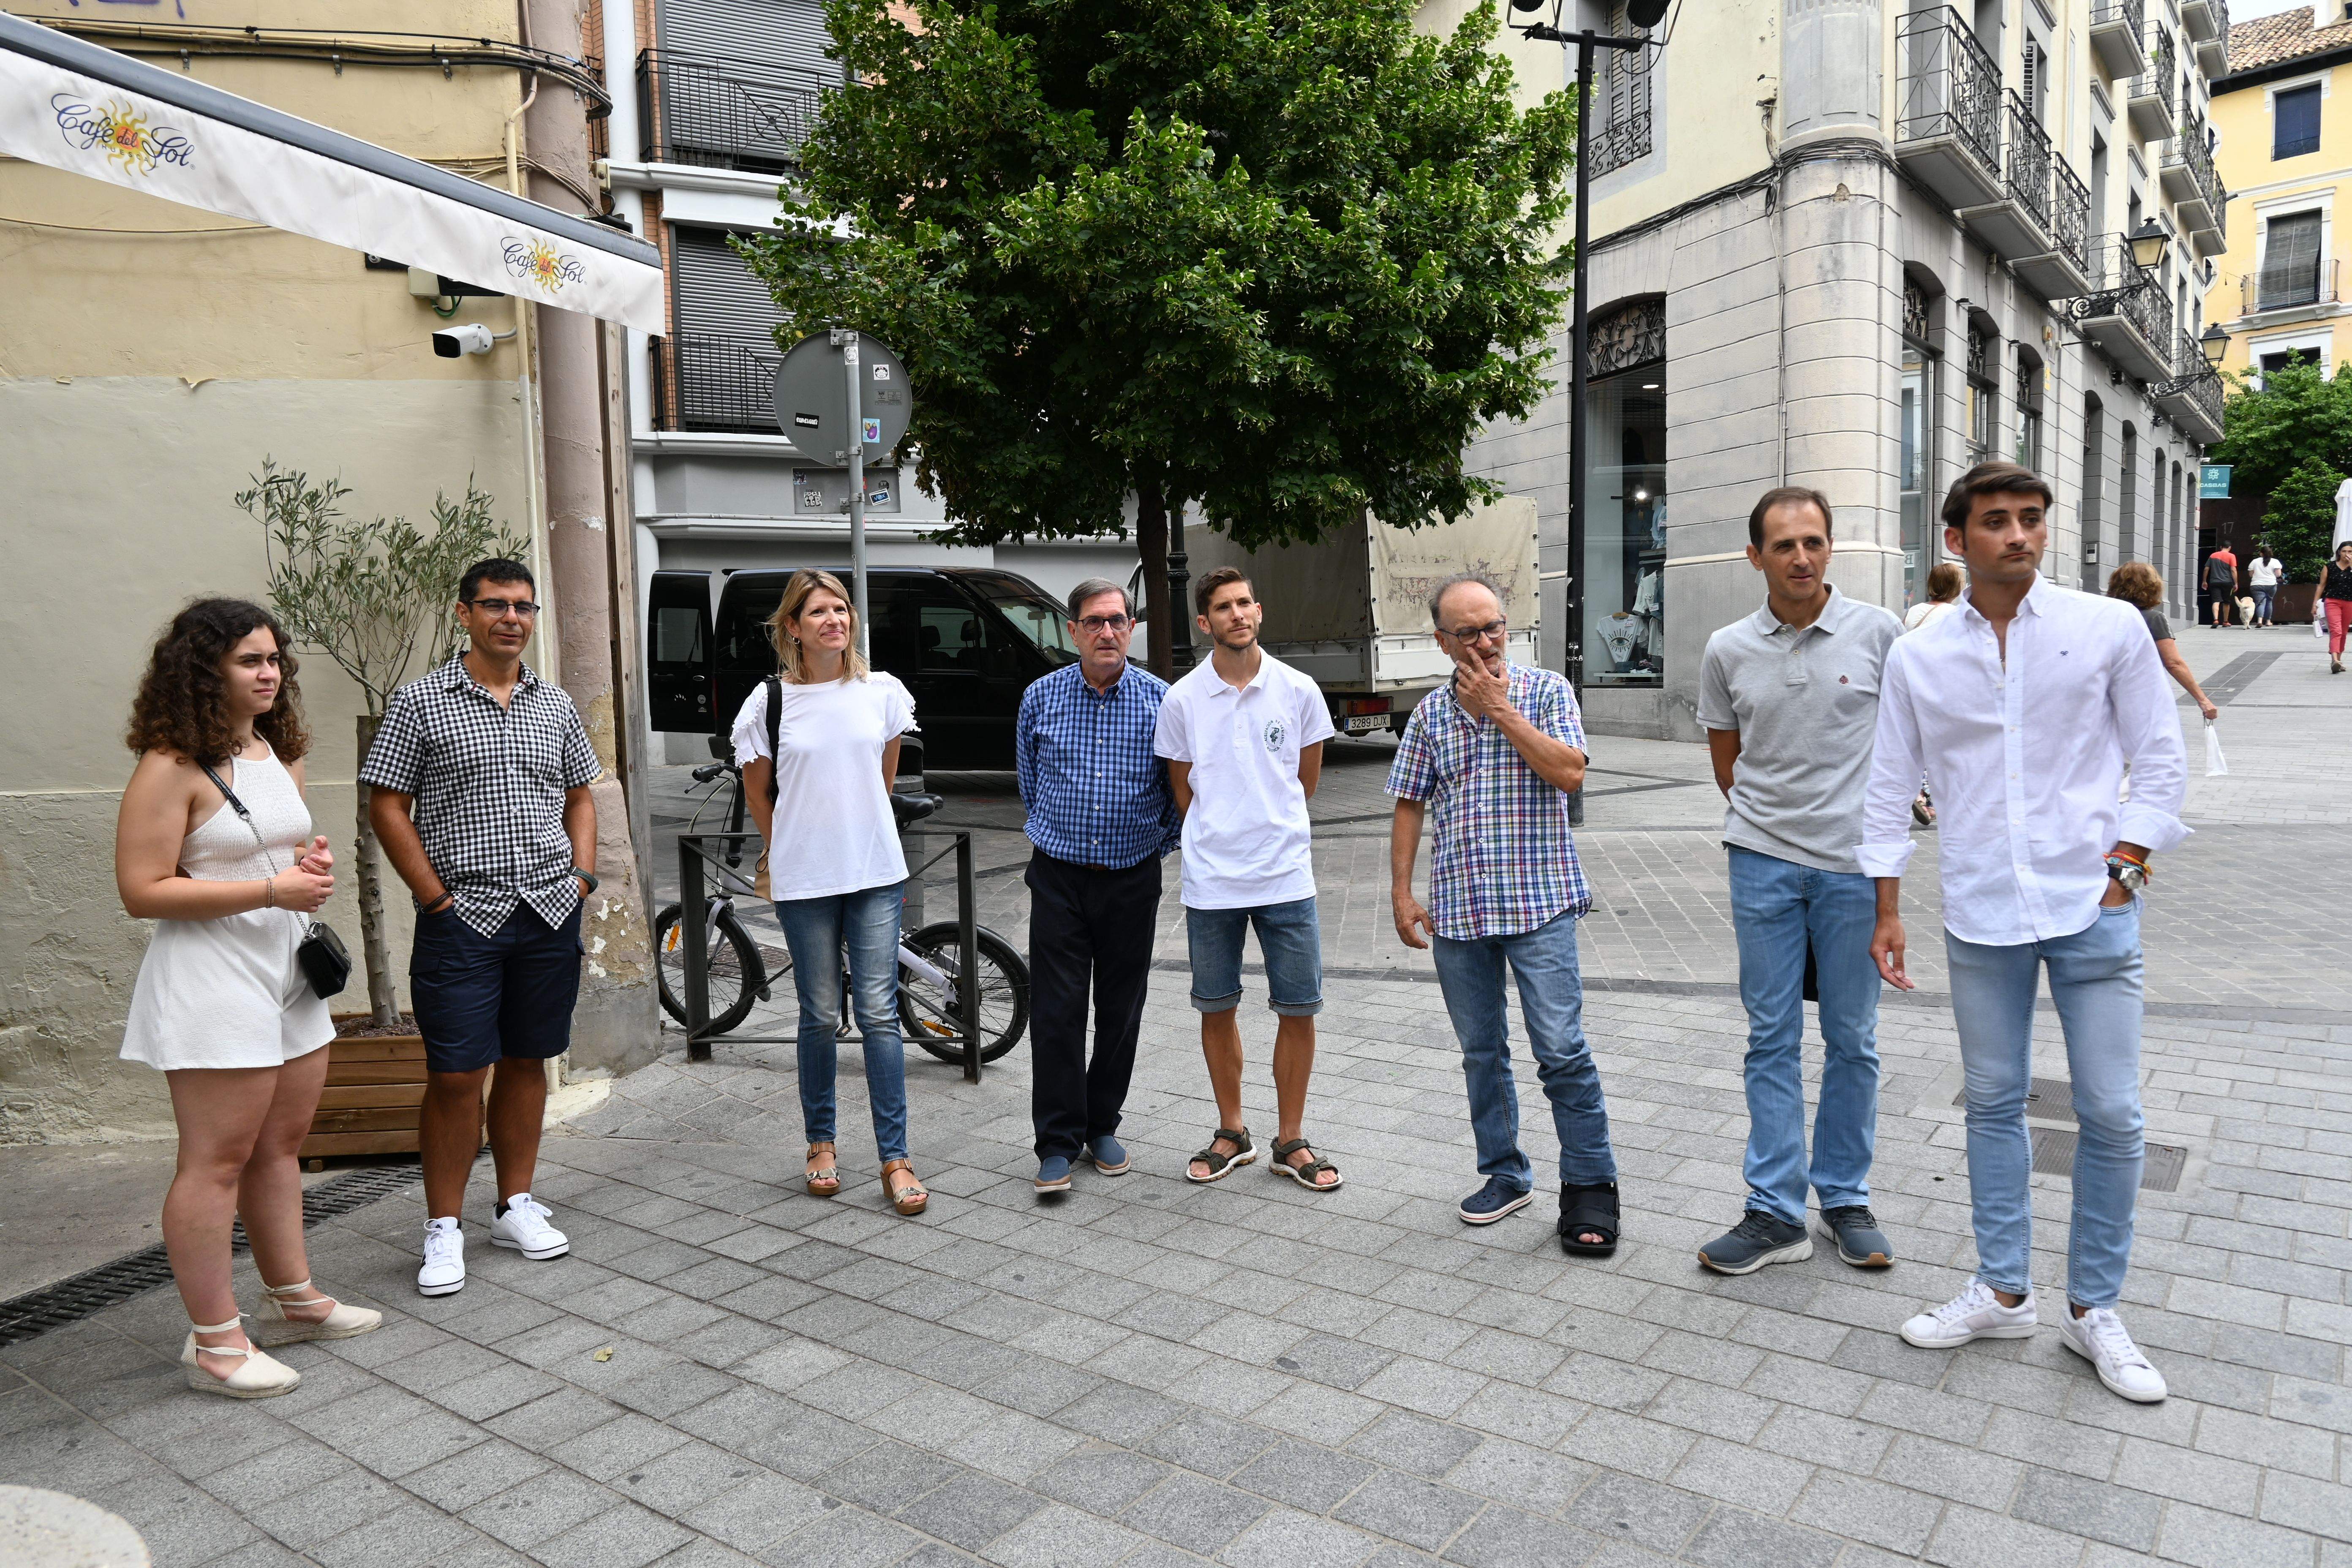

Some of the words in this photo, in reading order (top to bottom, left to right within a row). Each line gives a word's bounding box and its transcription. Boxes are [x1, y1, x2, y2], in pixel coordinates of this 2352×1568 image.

[51, 93, 118, 150] Café
[117, 128, 138, 147] del
[142, 127, 195, 171] Sol
[102, 144, 149, 163] HUESCA
[501, 236, 540, 278] Café
[539, 259, 550, 273] del
[553, 255, 586, 289] Sol
[531, 272, 558, 282] HUESCA
[2222, 522, 2234, 534] 17
[1352, 718, 1371, 728] 3289
[1374, 716, 1387, 727] DJX
